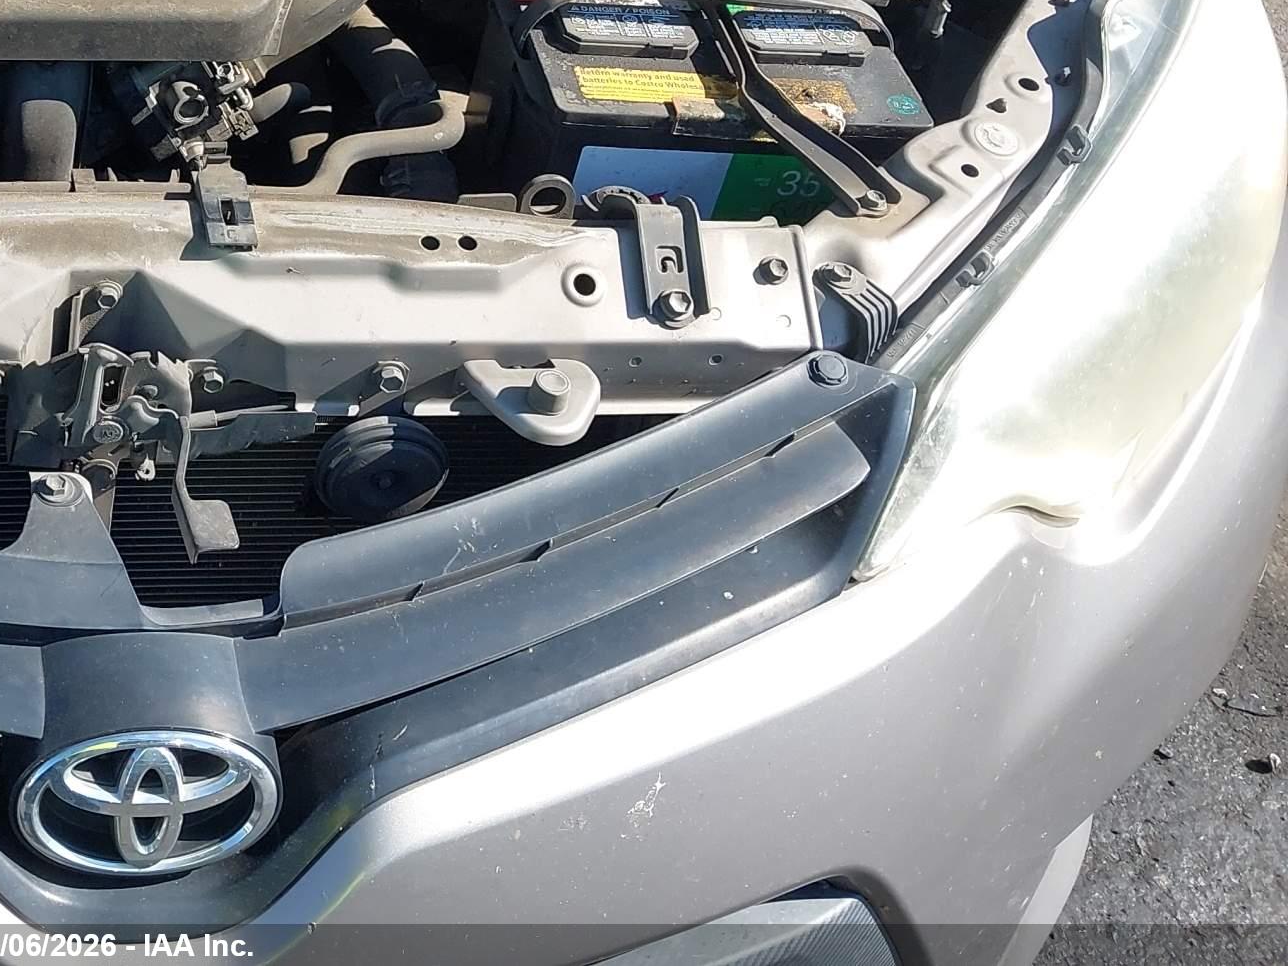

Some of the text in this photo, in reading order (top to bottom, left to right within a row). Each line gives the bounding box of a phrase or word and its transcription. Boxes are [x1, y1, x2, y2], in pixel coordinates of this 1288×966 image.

[580, 5, 622, 13] DANGER
[582, 75, 623, 84] batteries
[635, 79, 664, 88] Costco
[612, 71, 652, 81] warranty
[654, 73, 672, 81] and
[673, 74, 695, 82] used
[776, 170, 821, 197] 35
